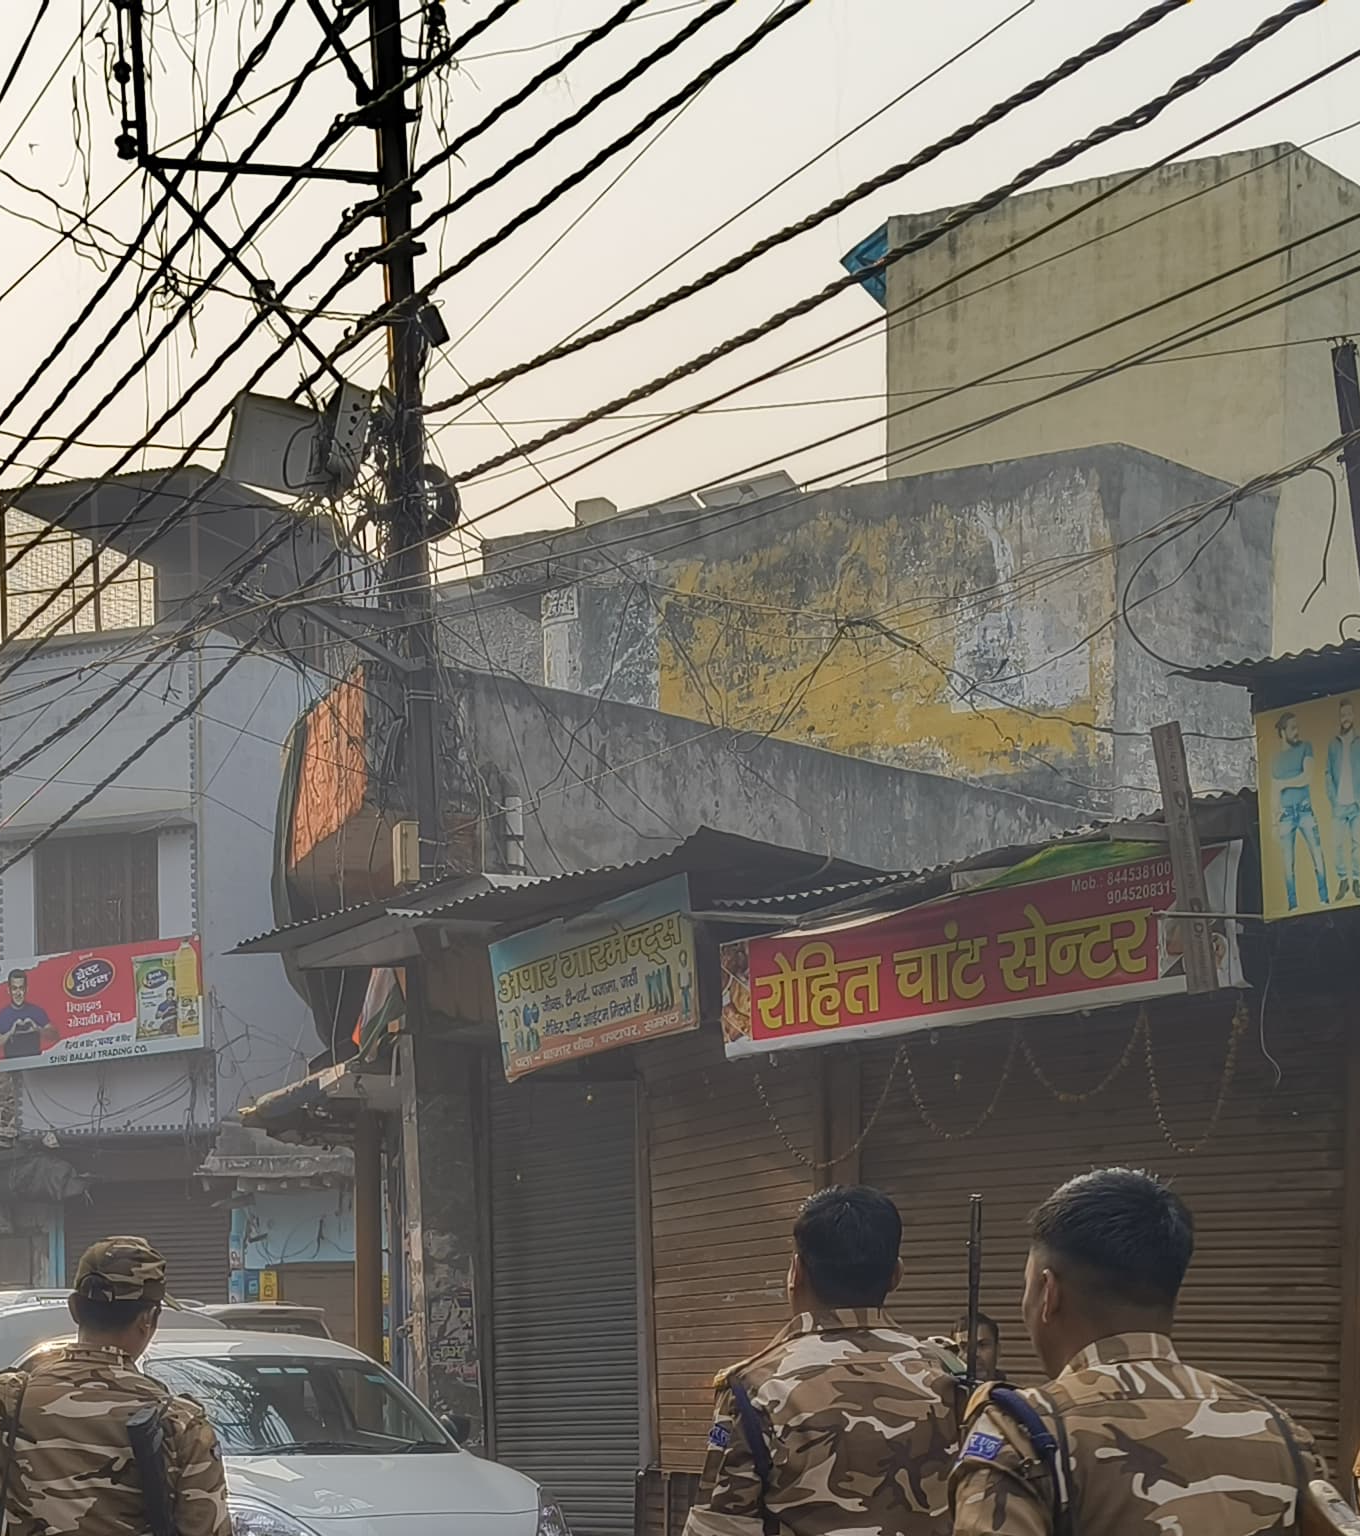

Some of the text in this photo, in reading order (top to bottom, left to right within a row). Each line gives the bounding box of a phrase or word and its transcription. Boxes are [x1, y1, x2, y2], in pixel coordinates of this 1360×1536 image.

[1107, 860, 1172, 886] 844538100
[497, 955, 558, 1004] अपार
[755, 903, 1154, 1030] रोहित चांट सेन्टर
[70, 1051, 96, 1062] BALAJI
[98, 1046, 132, 1058] TRADING
